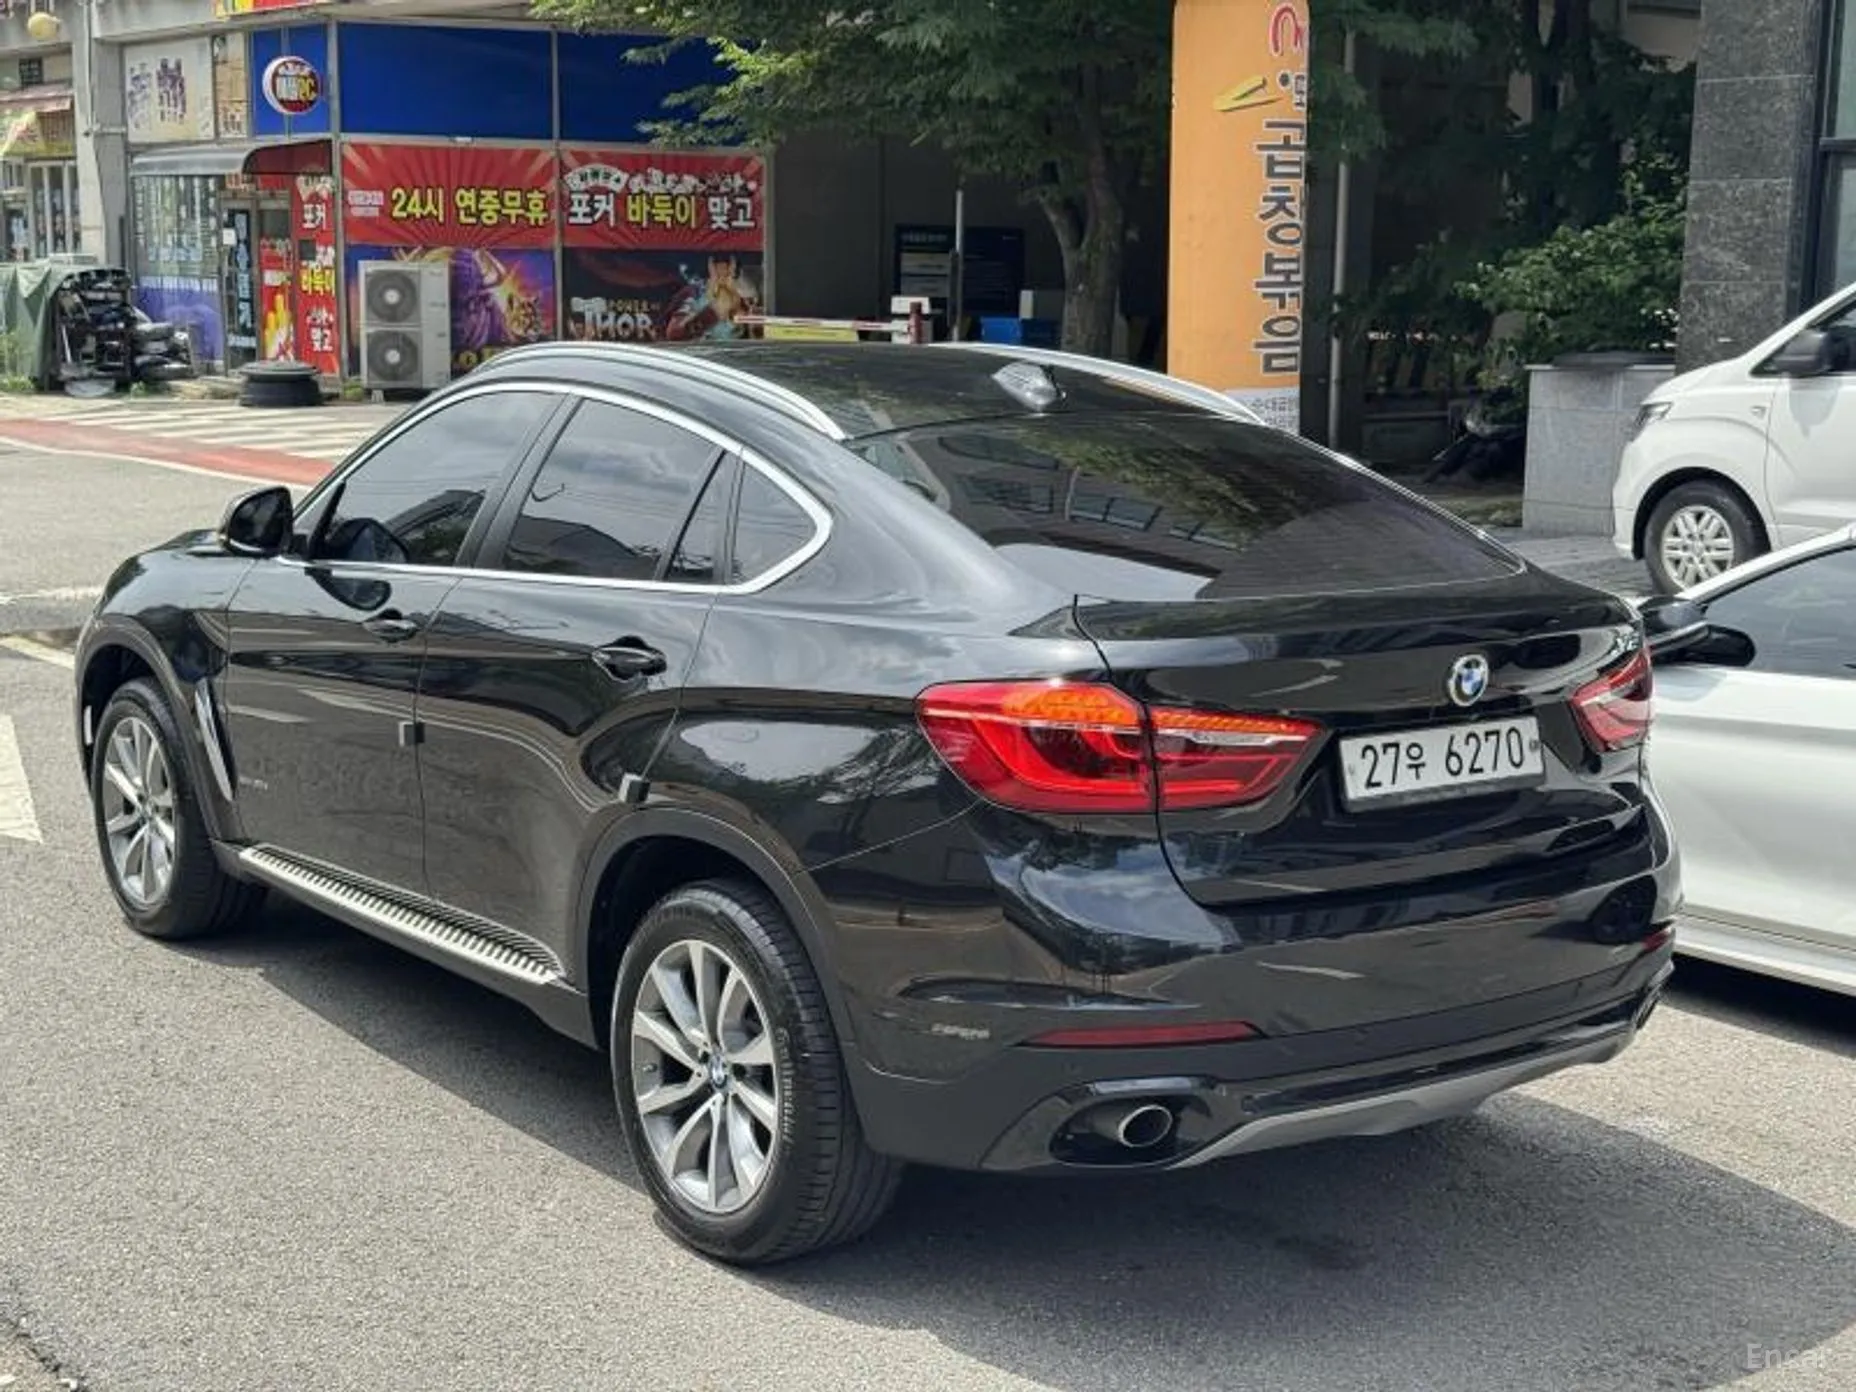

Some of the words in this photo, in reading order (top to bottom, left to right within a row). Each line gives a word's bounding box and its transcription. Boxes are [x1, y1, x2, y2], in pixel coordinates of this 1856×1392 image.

[391, 187, 444, 224] 24시
[454, 187, 549, 227] 연중무휴
[567, 192, 616, 228] 포커
[626, 193, 697, 230] 바둑이
[707, 194, 756, 231] 맞고
[571, 297, 657, 340] THOR
[1360, 741, 1427, 789] 27우
[1444, 726, 1524, 777] 6270
